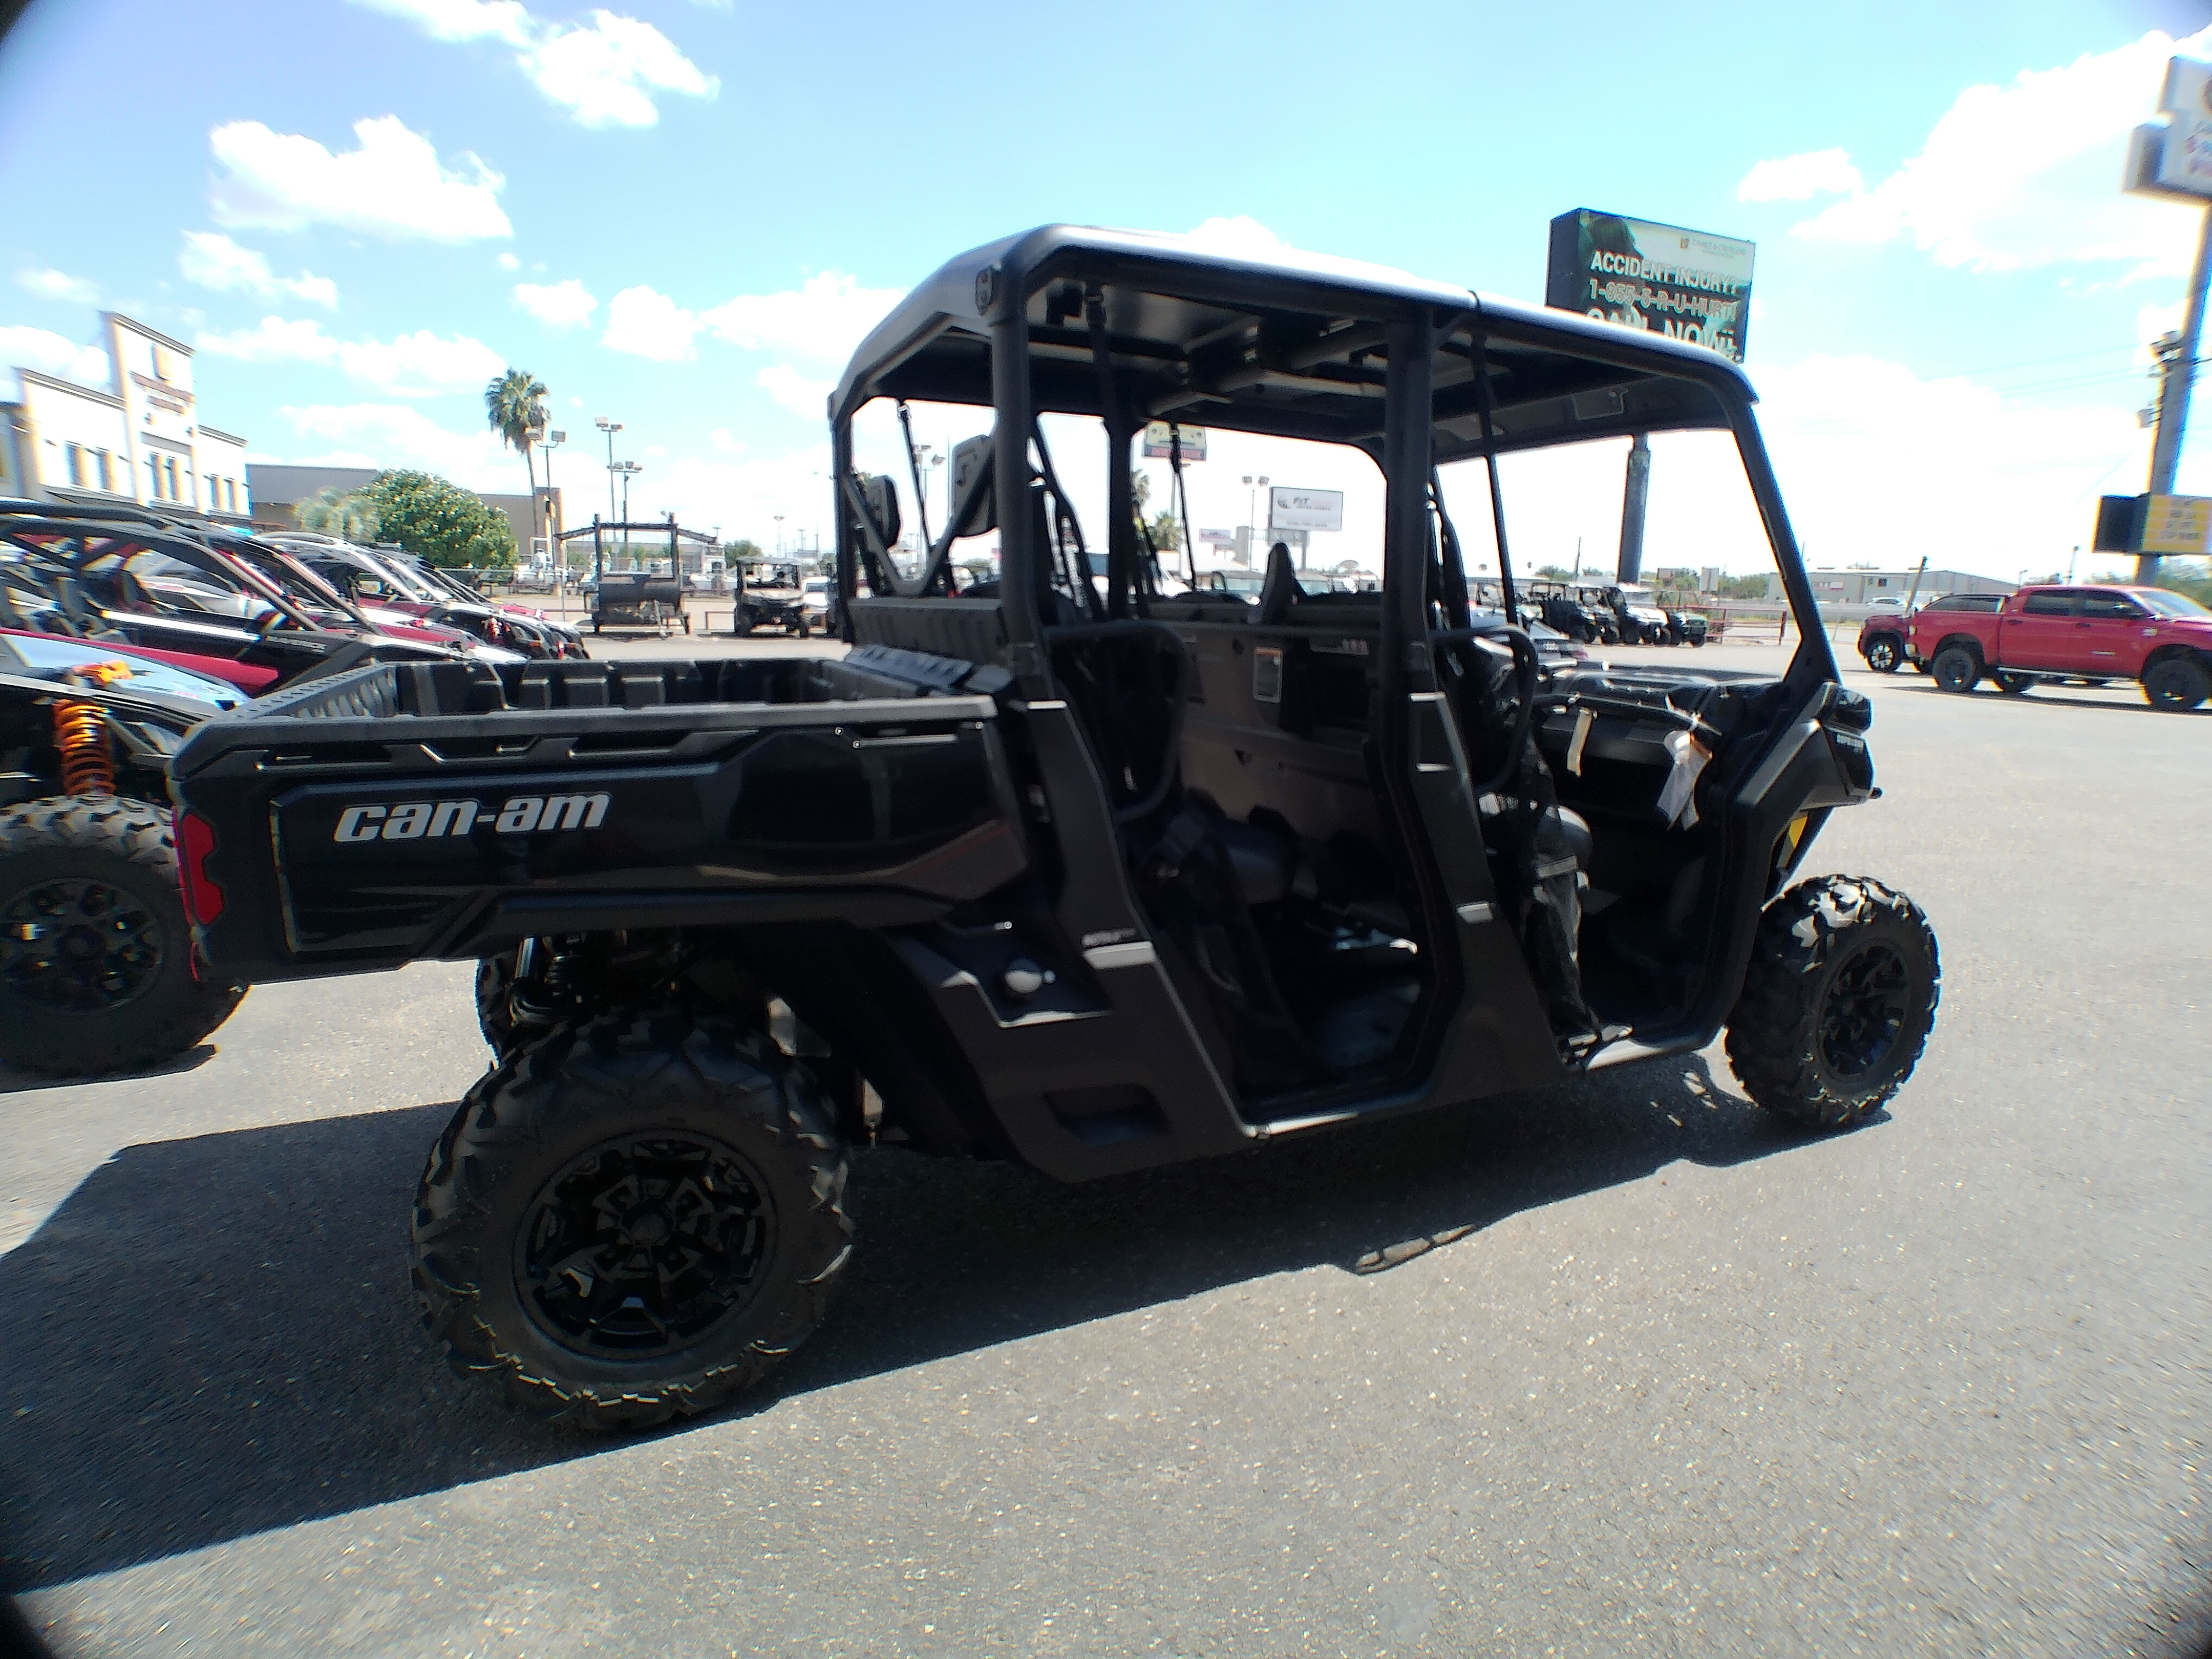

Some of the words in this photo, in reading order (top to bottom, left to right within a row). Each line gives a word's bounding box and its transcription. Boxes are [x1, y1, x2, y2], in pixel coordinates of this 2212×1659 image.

[1590, 250, 1672, 282] ACCIDENT
[1674, 265, 1739, 294] INJURY?
[1152, 447, 1201, 459] SEICE
[333, 793, 611, 842] can-am
